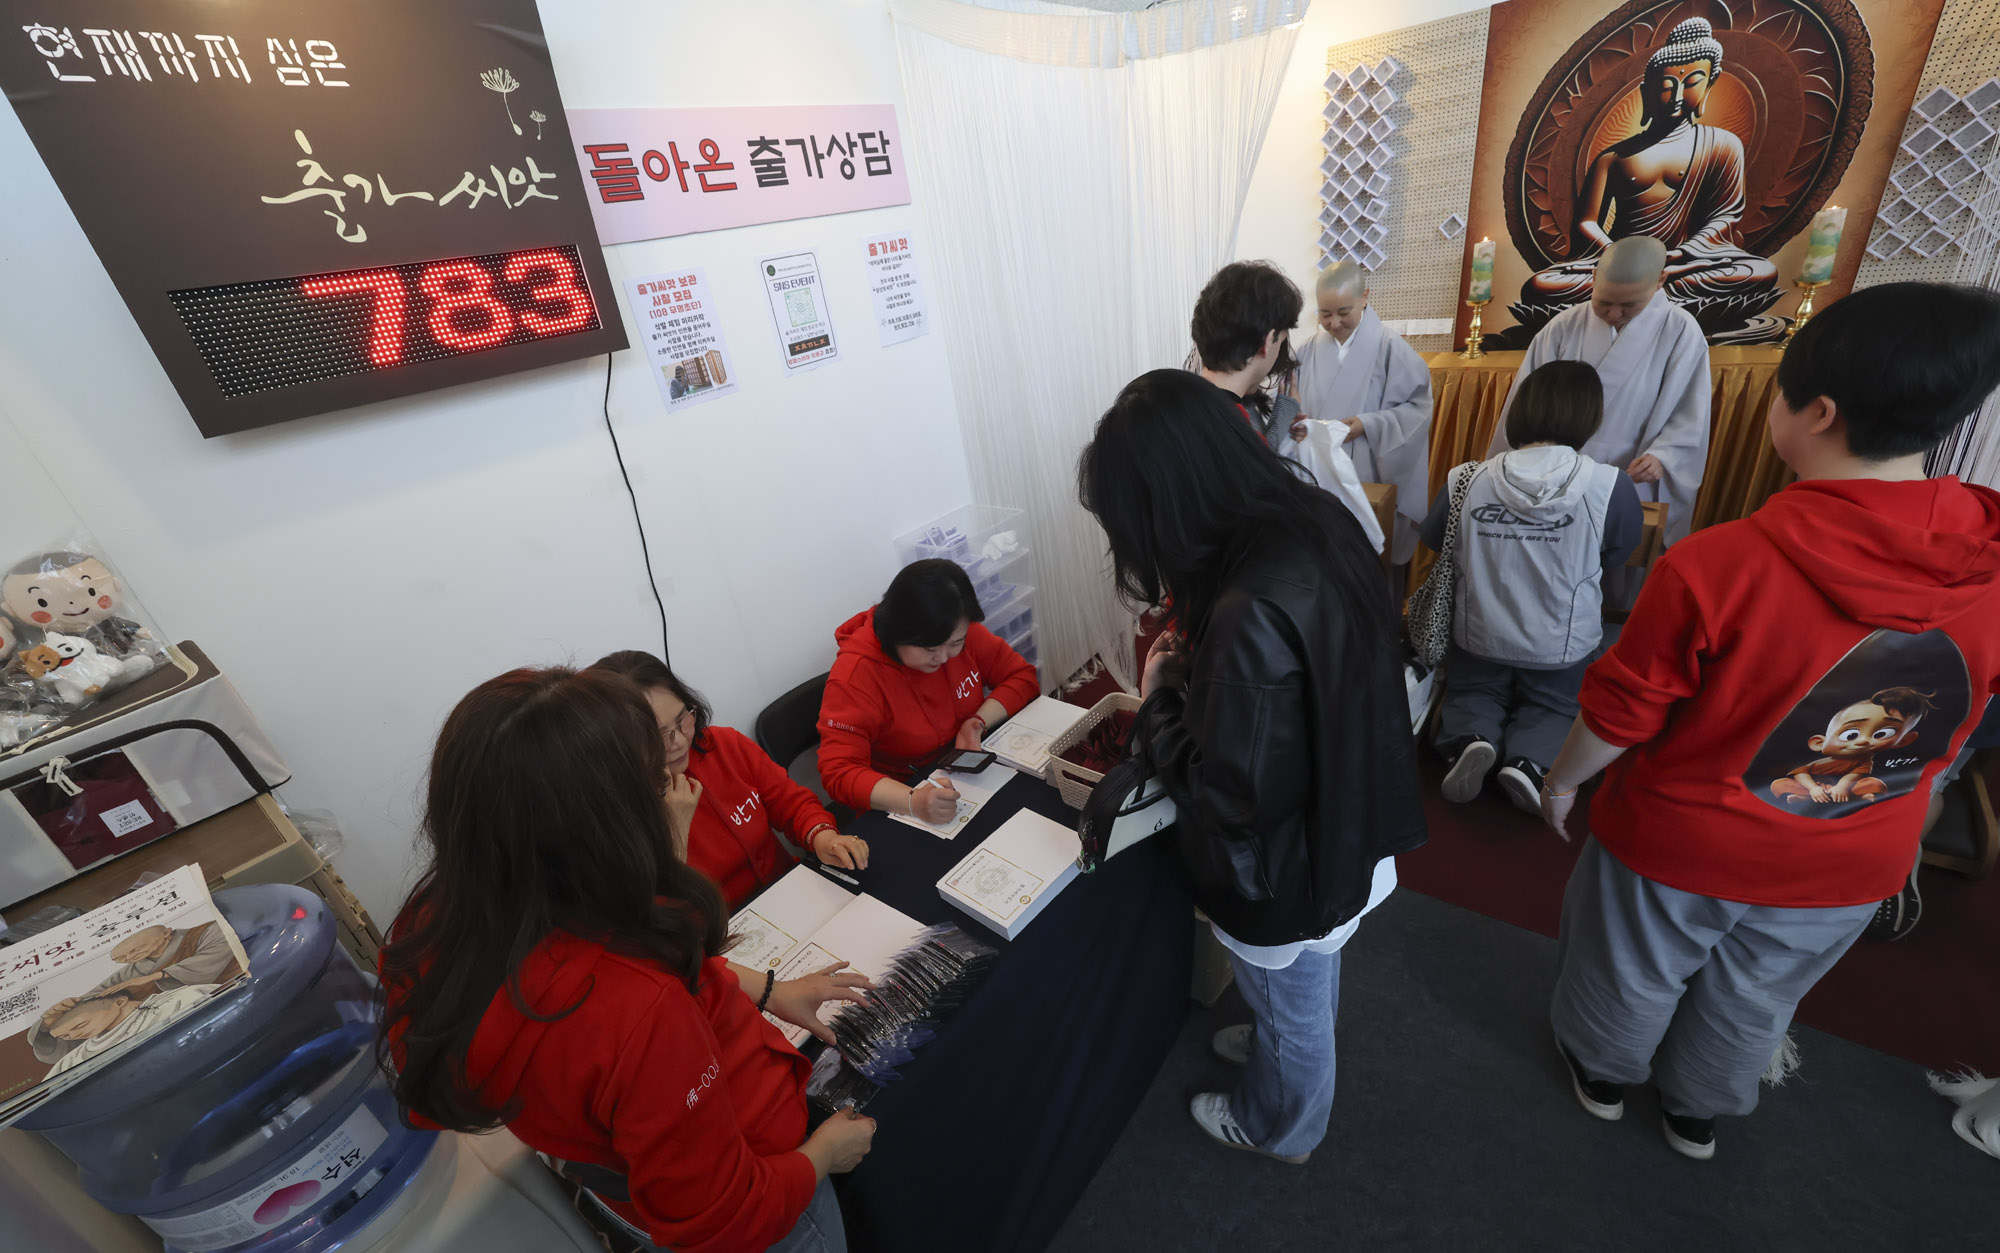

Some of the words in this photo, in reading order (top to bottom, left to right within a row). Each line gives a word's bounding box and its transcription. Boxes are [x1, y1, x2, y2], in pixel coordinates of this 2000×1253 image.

[22, 22, 252, 84] 현재까지
[267, 37, 350, 87] 심은
[583, 138, 738, 204] 돌아온
[747, 130, 892, 188] 출가상담
[868, 238, 908, 256] 출가씨앗
[636, 279, 677, 295] 출가씨앗
[678, 275, 697, 287] 보관
[773, 280, 790, 292] SNS
[791, 275, 816, 288] EVENT
[301, 250, 592, 366] 783
[652, 293, 671, 307] 사찰
[673, 289, 692, 302] 모집
[681, 313, 705, 325] 머리카락
[1477, 530, 1502, 539] WHICH
[955, 670, 981, 701] 반가
[1885, 755, 1918, 770] 반가
[729, 789, 762, 827] 반가
[90, 890, 181, 938] 솔루션
[321, 1147, 361, 1180] 석수
[276, 1165, 299, 1184] 18.9L
